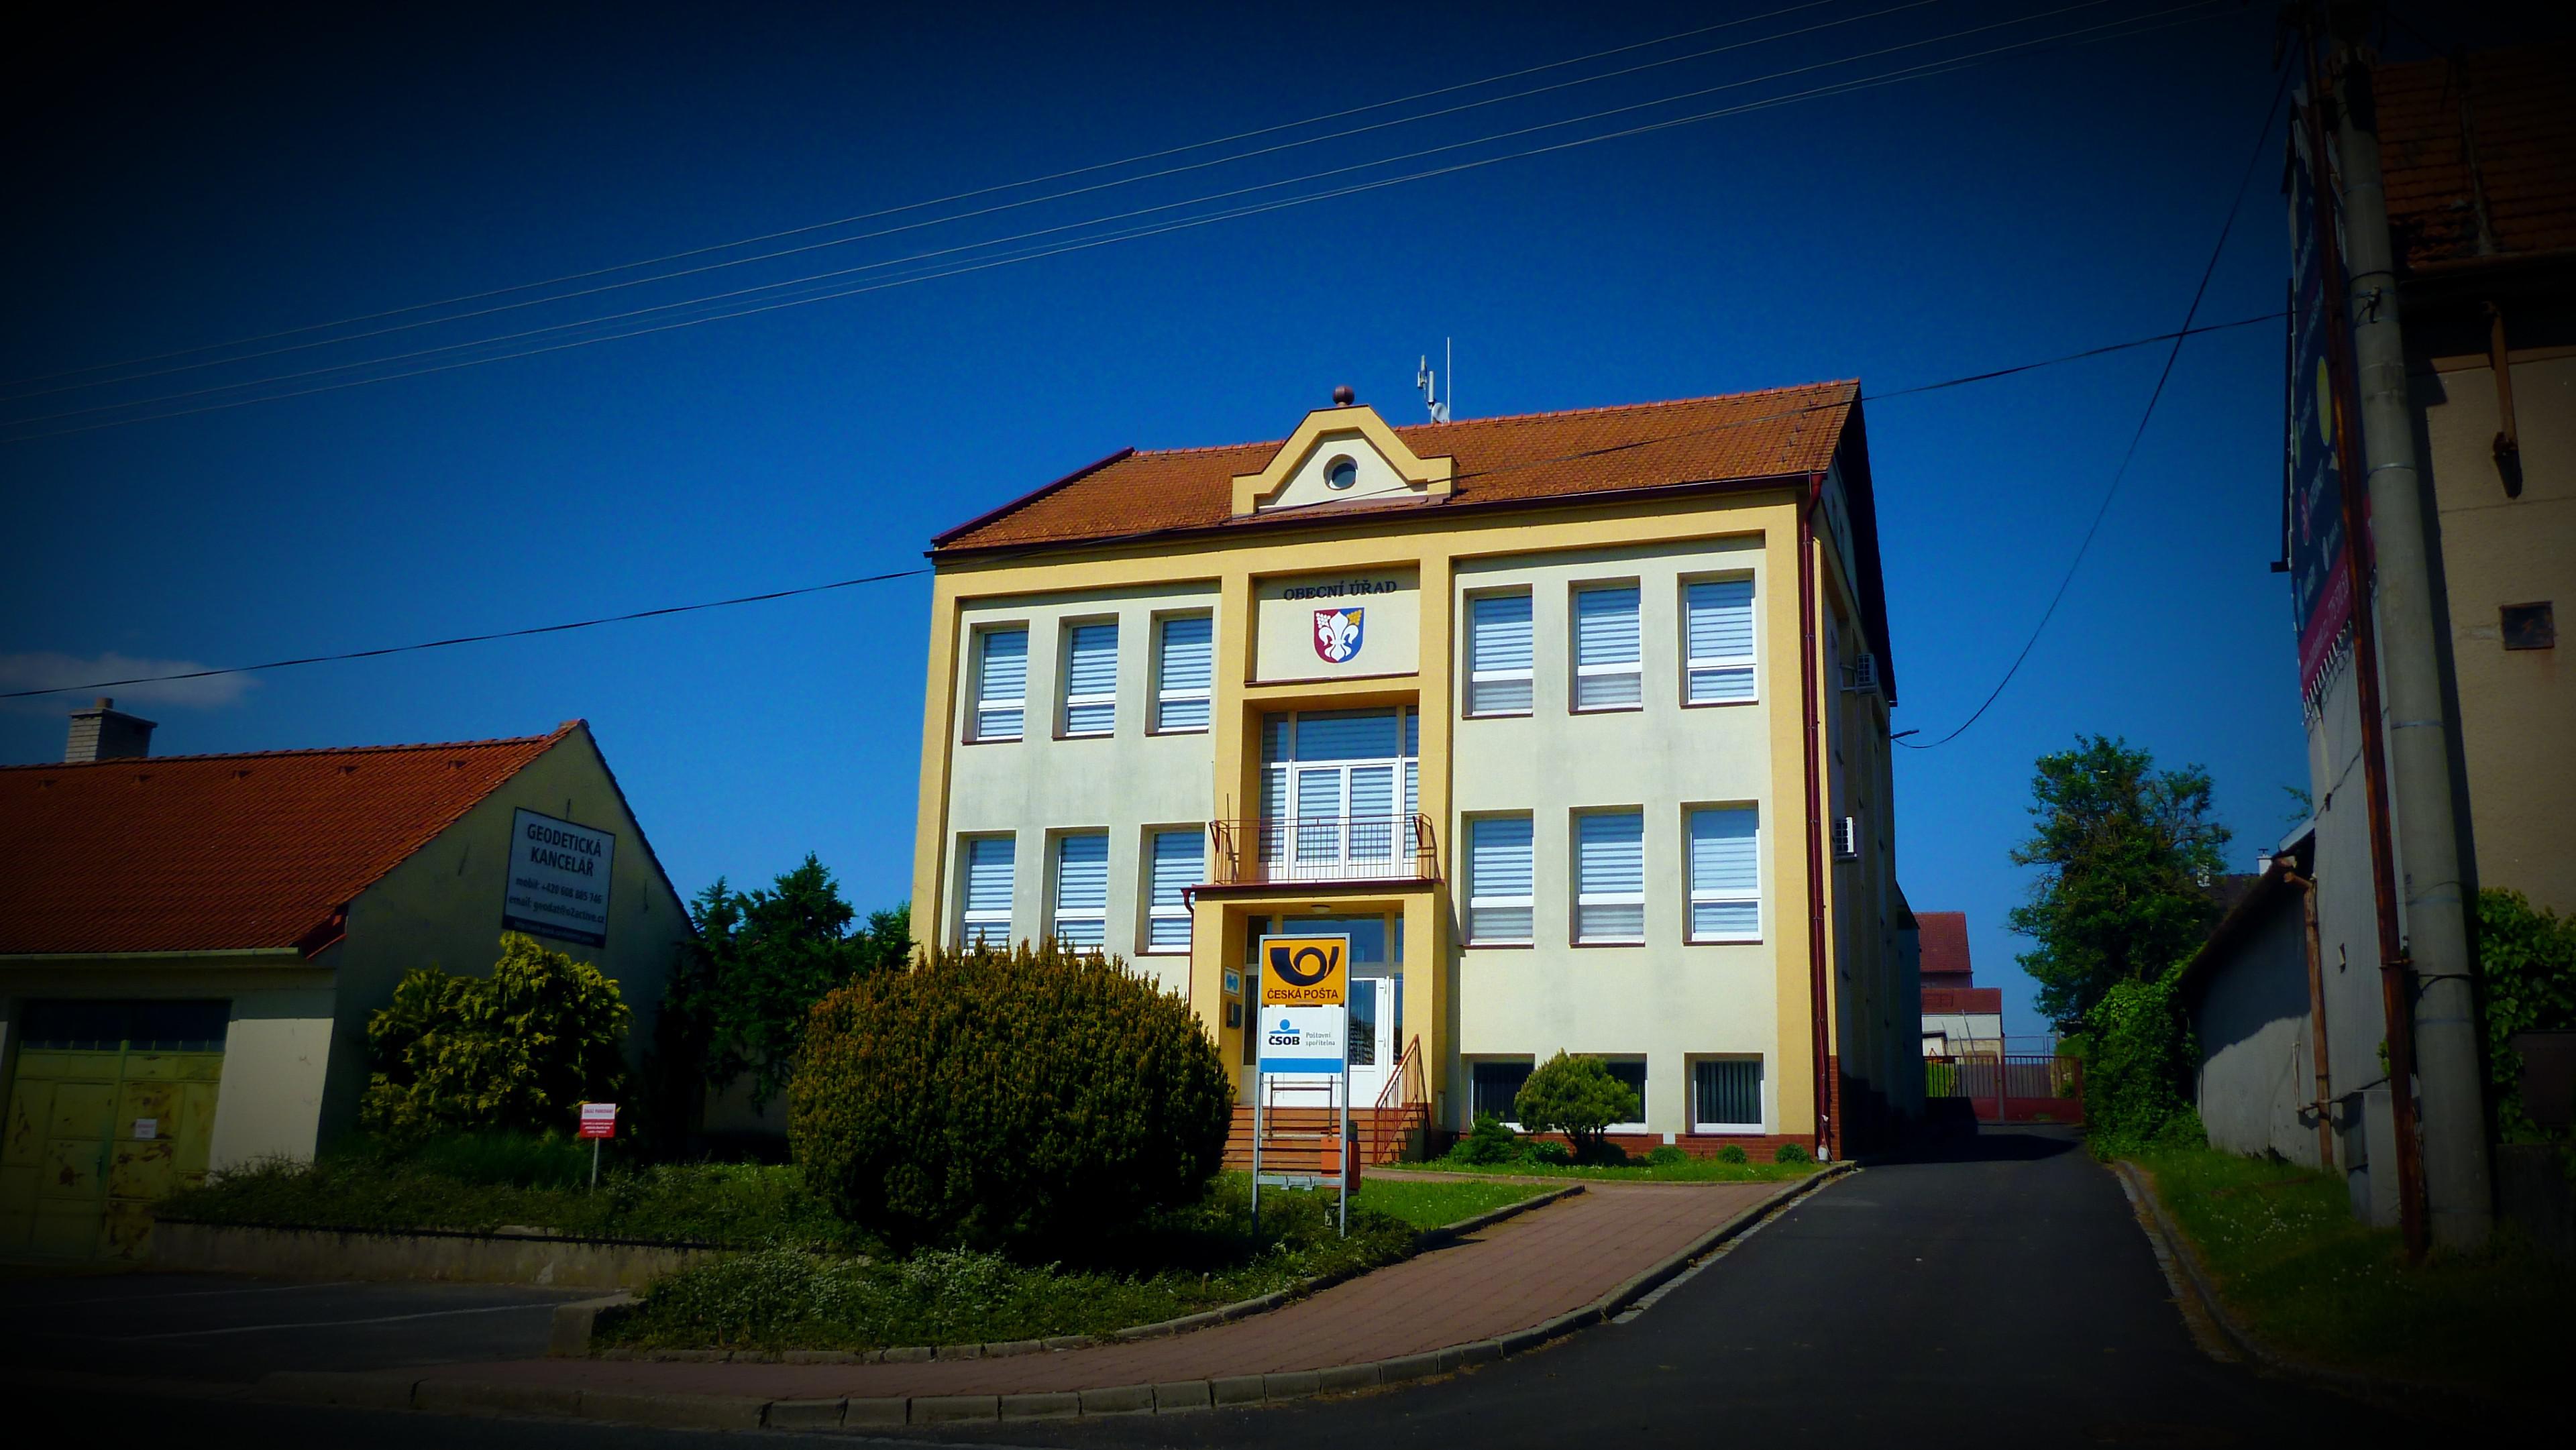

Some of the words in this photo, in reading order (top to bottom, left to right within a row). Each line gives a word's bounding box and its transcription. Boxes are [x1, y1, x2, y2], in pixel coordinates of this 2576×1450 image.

[1283, 581, 1344, 600] OBECNÍ
[1349, 579, 1397, 596] ÚŘAD
[527, 823, 601, 857] GEODETICKÁ
[531, 846, 594, 877] KANCELÁŘ
[1267, 988, 1301, 999] ČESKÁ
[1304, 987, 1338, 999] POŠTA
[1269, 1036, 1300, 1045] ČSOB
